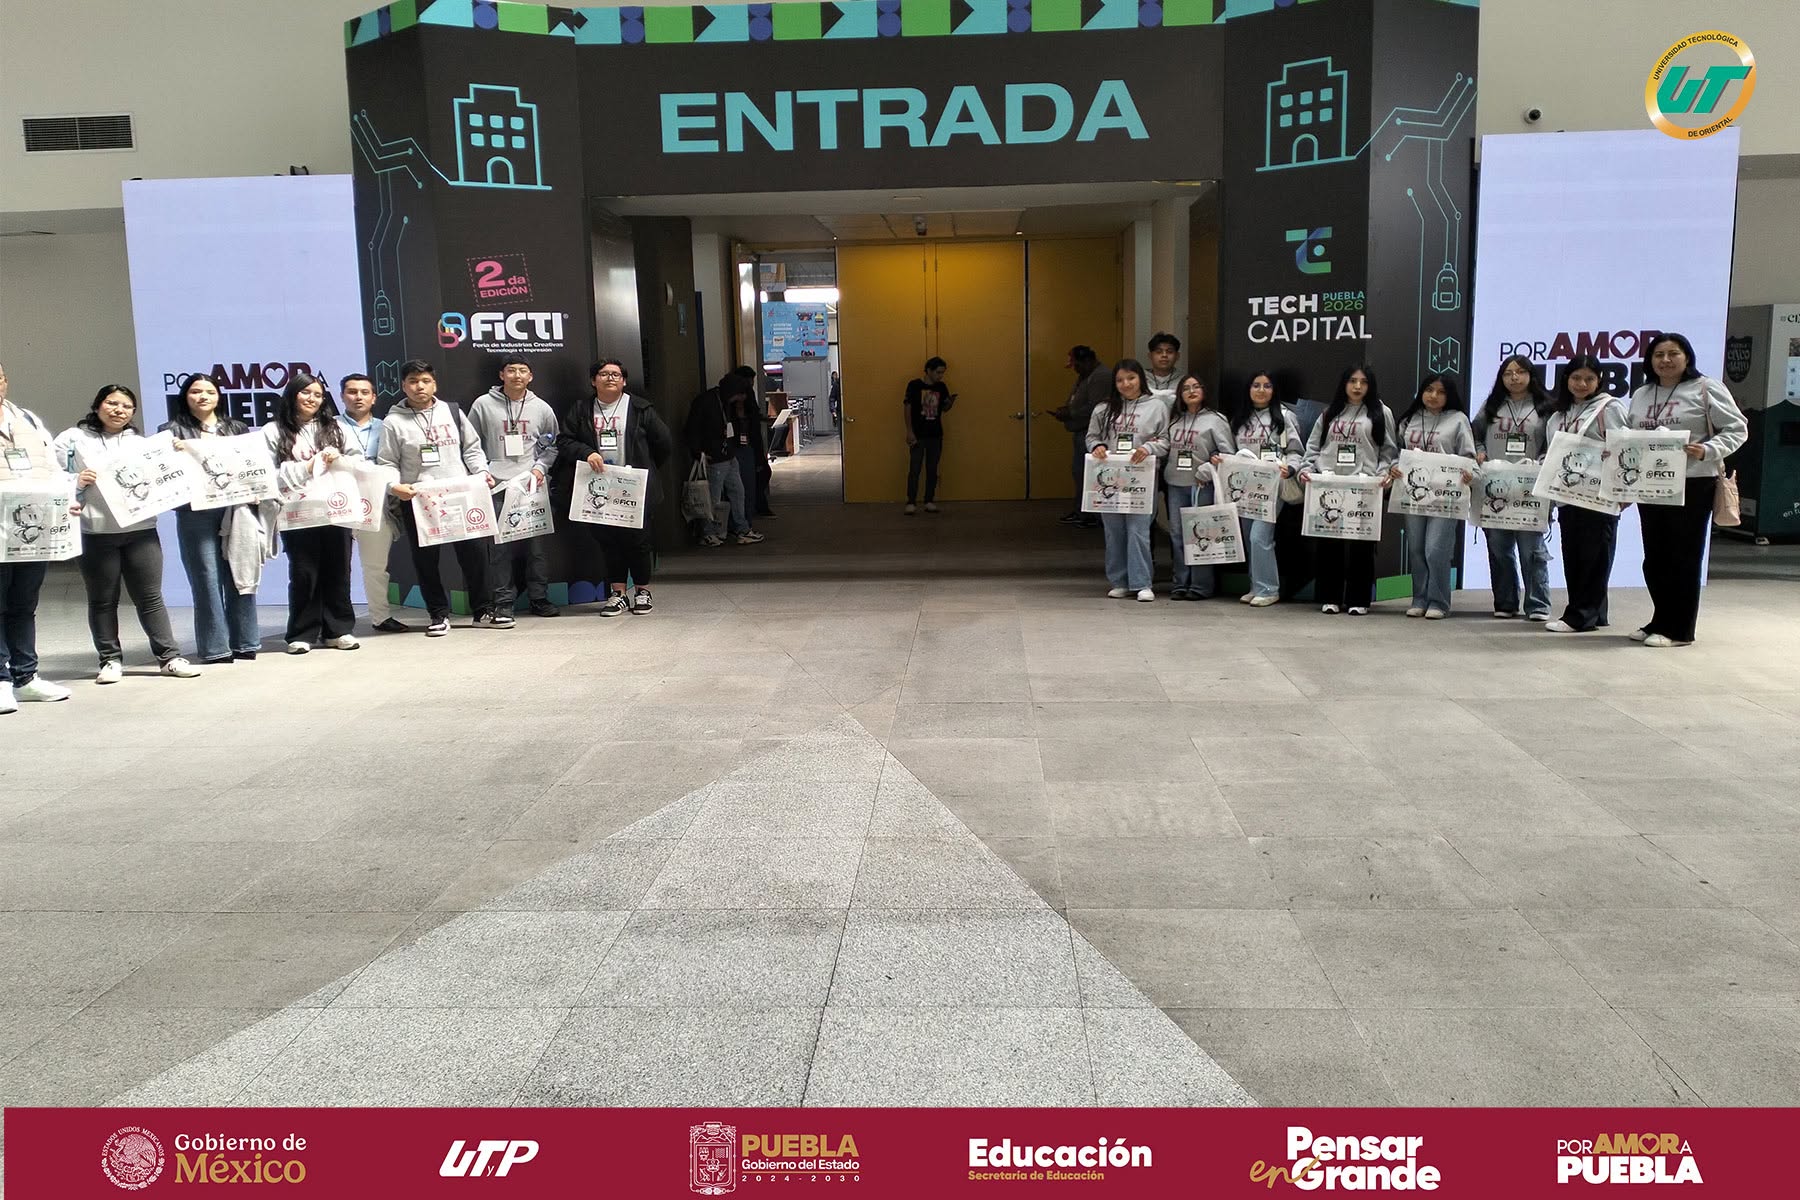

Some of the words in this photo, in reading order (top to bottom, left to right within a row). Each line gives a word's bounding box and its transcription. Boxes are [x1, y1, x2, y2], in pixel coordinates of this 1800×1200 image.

[660, 79, 1150, 153] ENTRADA
[480, 285, 528, 298] EDICIÓN
[1248, 294, 1318, 316] TECH
[1322, 291, 1365, 301] PUEBLA
[1323, 299, 1364, 312] 2026
[1247, 315, 1373, 343] CAPITAL
[1500, 341, 1547, 361] POR
[593, 417, 620, 432] UT
[1332, 420, 1362, 437] UT
[1173, 429, 1200, 446] UT
[1409, 430, 1440, 445] UT
